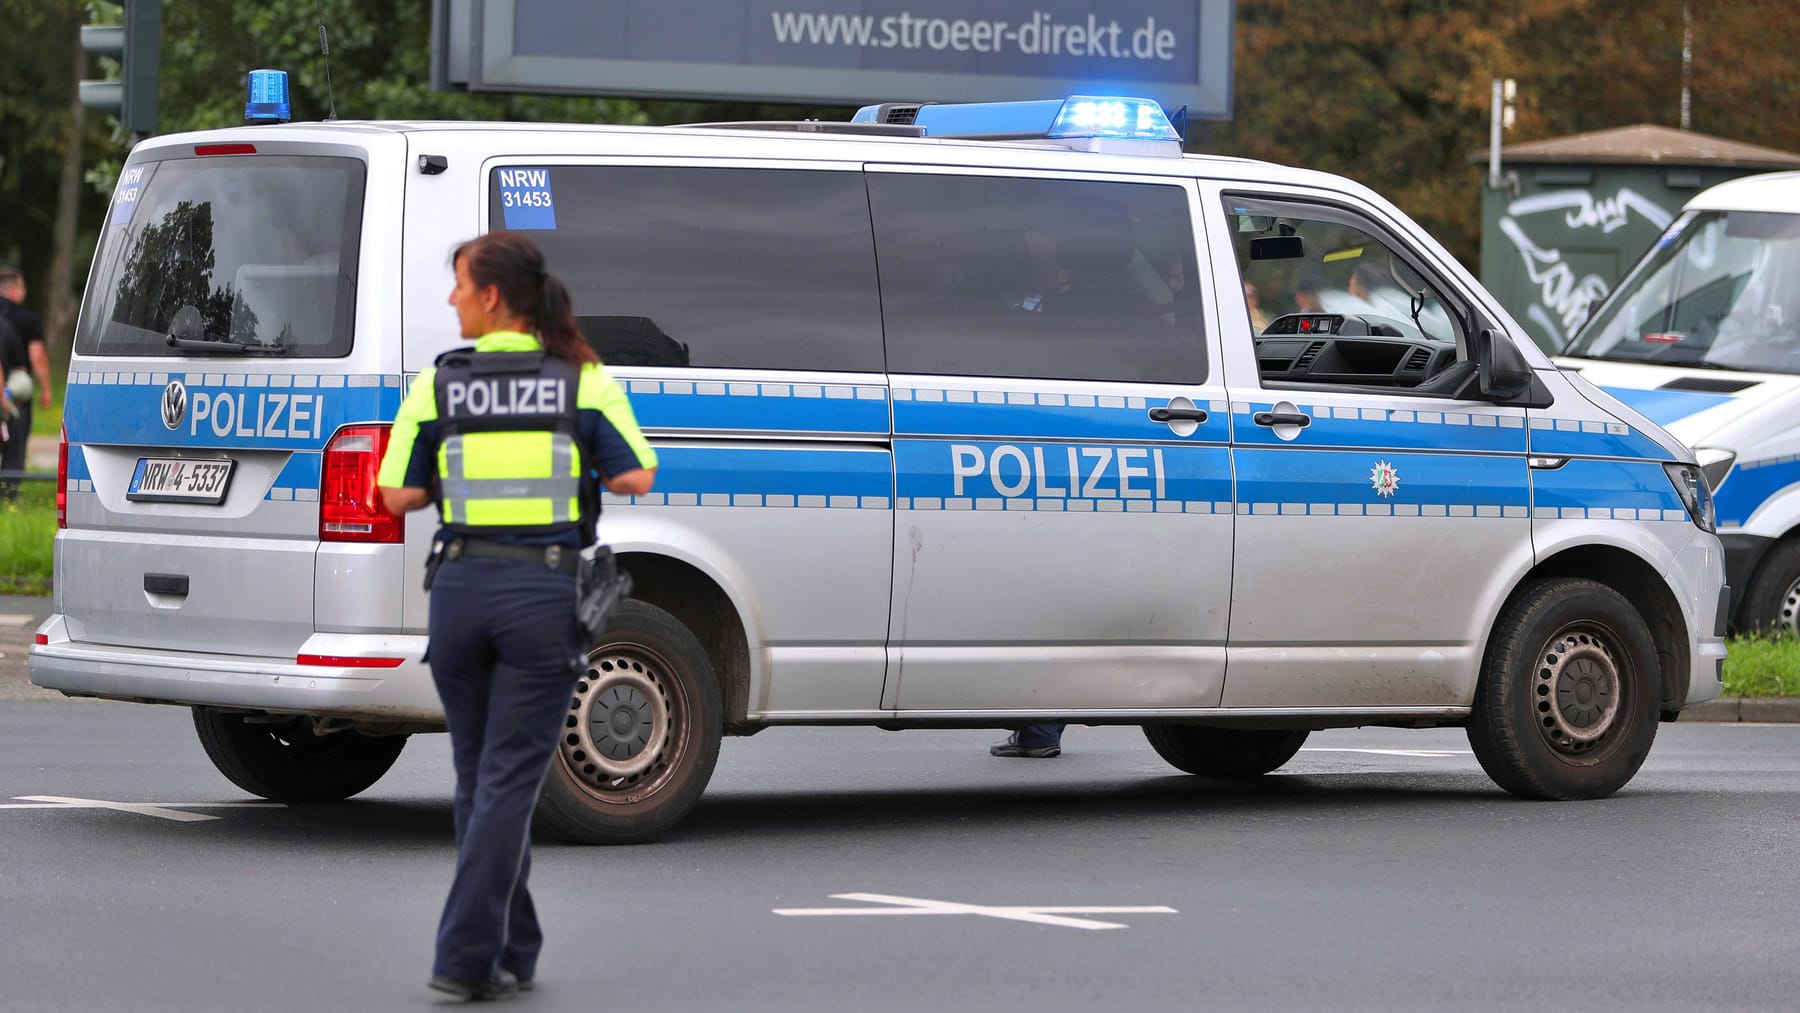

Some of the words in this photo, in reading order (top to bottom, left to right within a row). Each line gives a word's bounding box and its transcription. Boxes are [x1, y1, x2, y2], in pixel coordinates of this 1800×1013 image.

[772, 11, 1176, 61] www.stroeer-direkt.de
[500, 170, 546, 188] NRW
[503, 191, 552, 207] 31453
[191, 392, 324, 440] POLIZEI
[447, 379, 566, 417] POLIZEI
[139, 463, 171, 490] NRW
[174, 463, 229, 493] 4-5337
[951, 444, 1166, 499] POLIZEI
